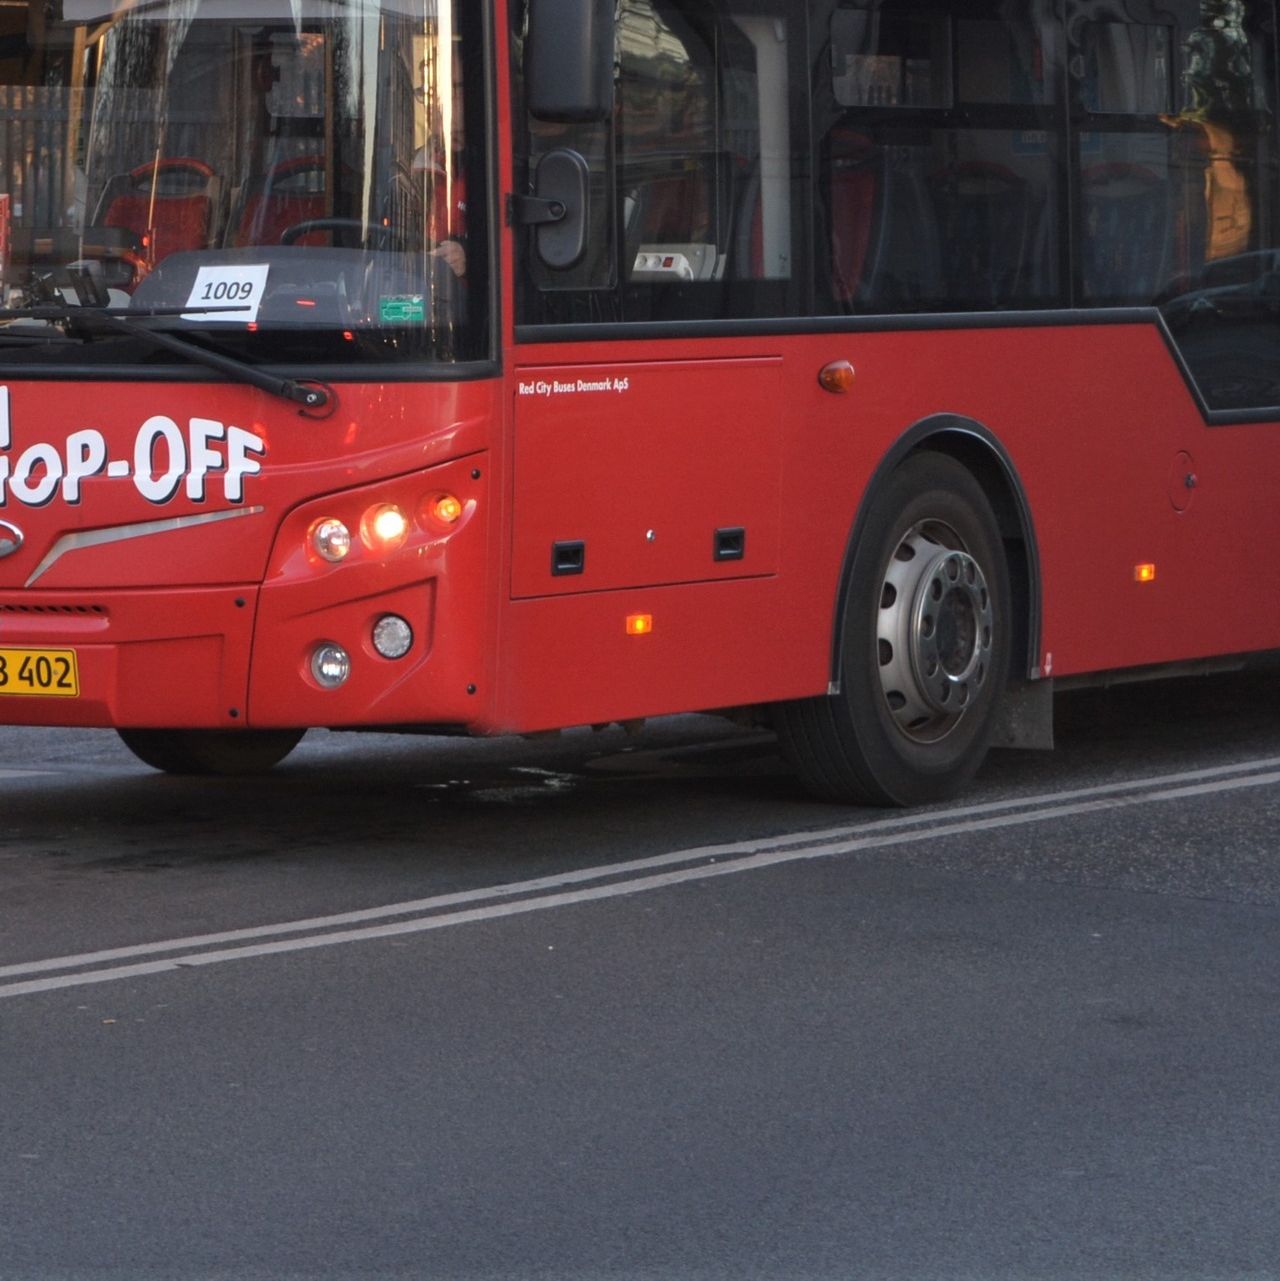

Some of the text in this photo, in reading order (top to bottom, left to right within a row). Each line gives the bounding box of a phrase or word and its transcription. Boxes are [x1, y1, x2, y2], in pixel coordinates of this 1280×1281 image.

[201, 281, 253, 300] 1009
[519, 378, 629, 397] Red City Buses Denmark ApS
[18, 656, 73, 688] 402
